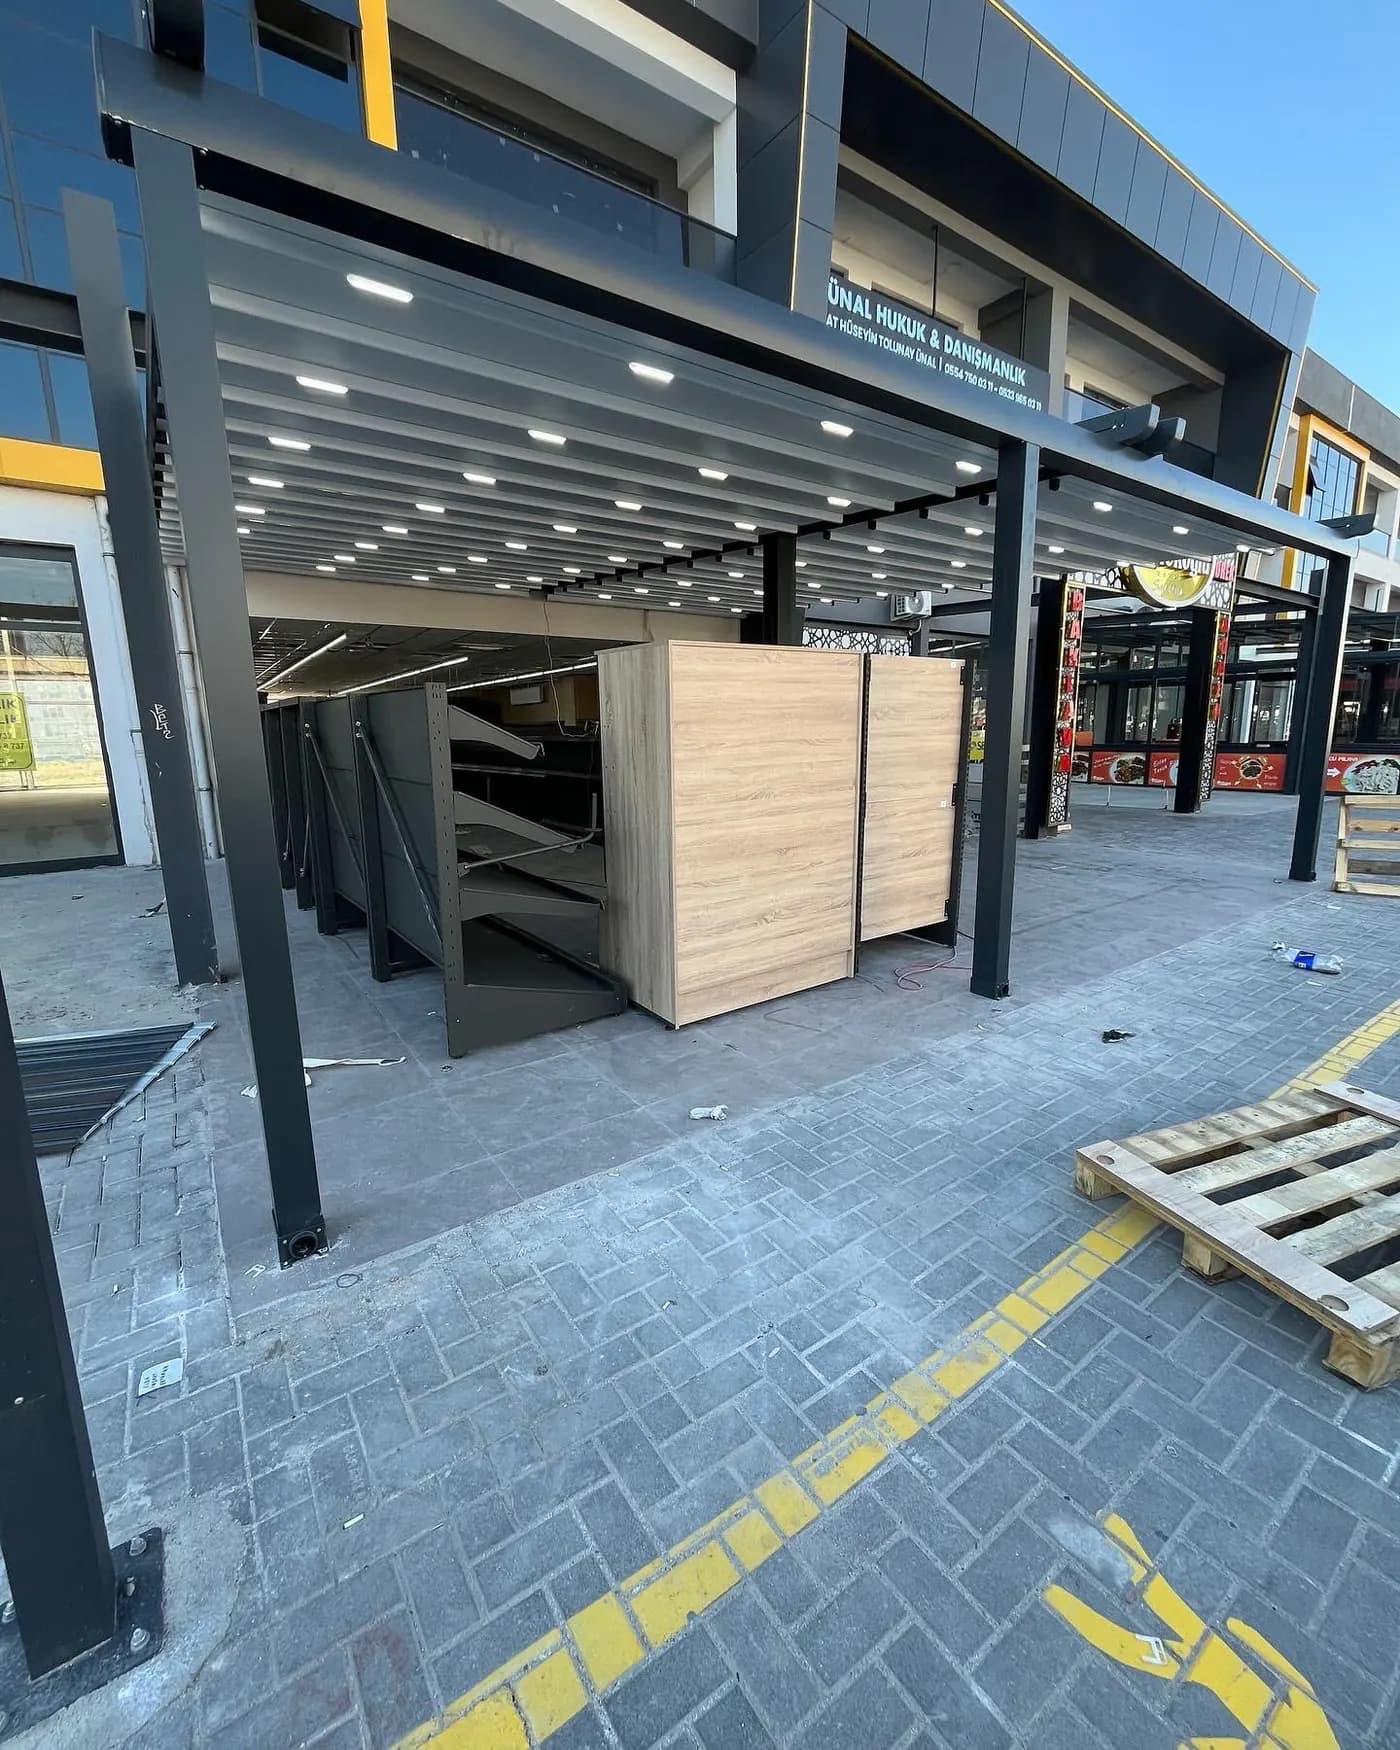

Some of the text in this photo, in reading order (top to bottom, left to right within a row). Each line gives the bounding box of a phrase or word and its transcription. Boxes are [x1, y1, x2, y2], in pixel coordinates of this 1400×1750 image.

[827, 276, 1026, 386] ÜNAL HUKUK & DANIŞMANLIK
[839, 318, 878, 345] HÜSEYİN
[878, 334, 916, 361] TOLUNAY
[915, 347, 937, 369] ÜNAL
[944, 363, 964, 380] 0554
[964, 370, 977, 386] 750
[977, 377, 987, 390] 03
